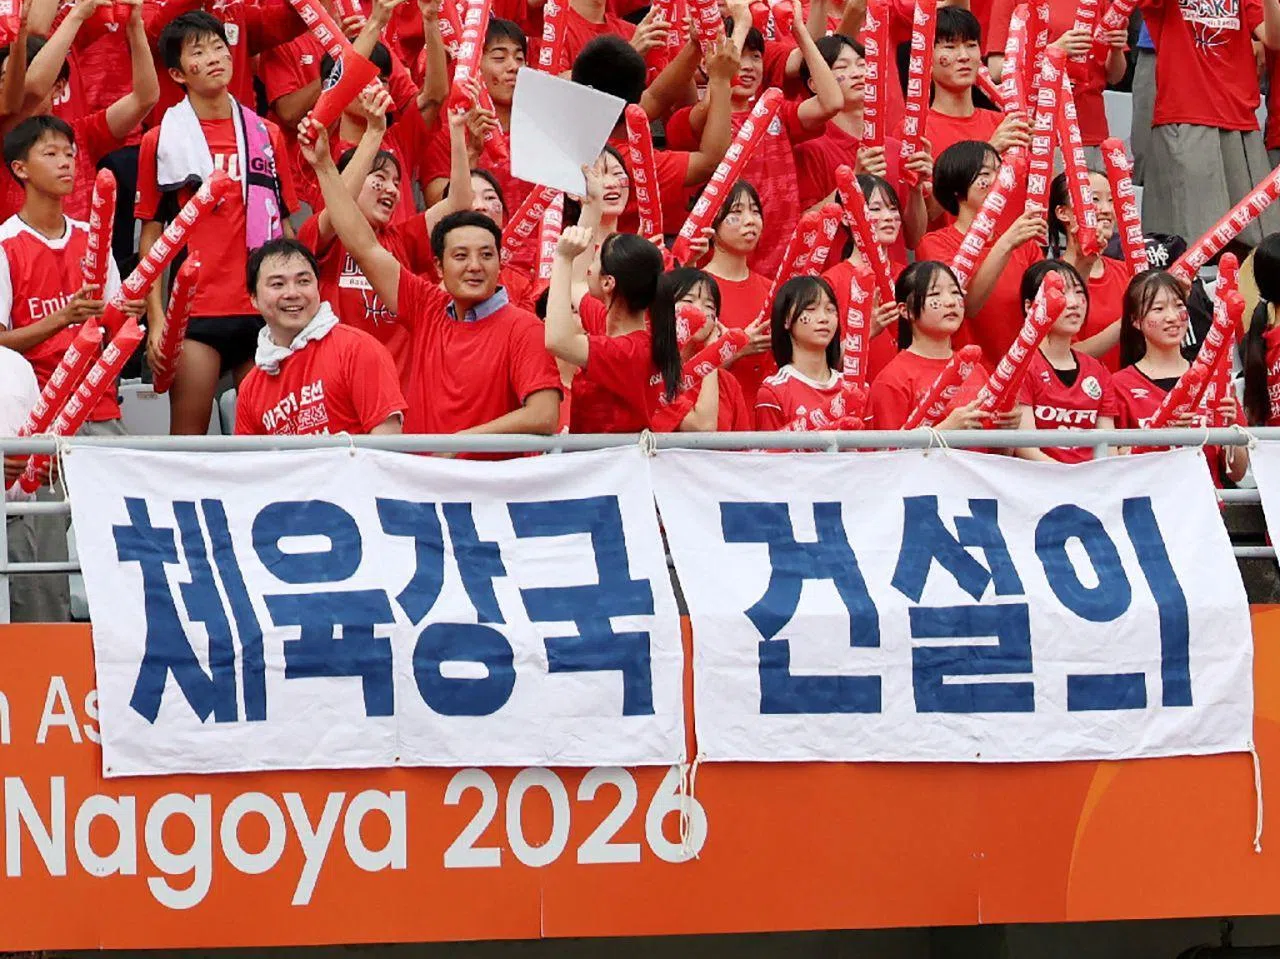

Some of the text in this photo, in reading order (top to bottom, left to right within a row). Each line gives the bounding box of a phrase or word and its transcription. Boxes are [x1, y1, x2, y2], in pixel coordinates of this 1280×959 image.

[113, 494, 657, 725] 체육강국
[718, 494, 1192, 716] 건설의
[4, 766, 708, 909] Nagoya 2026
